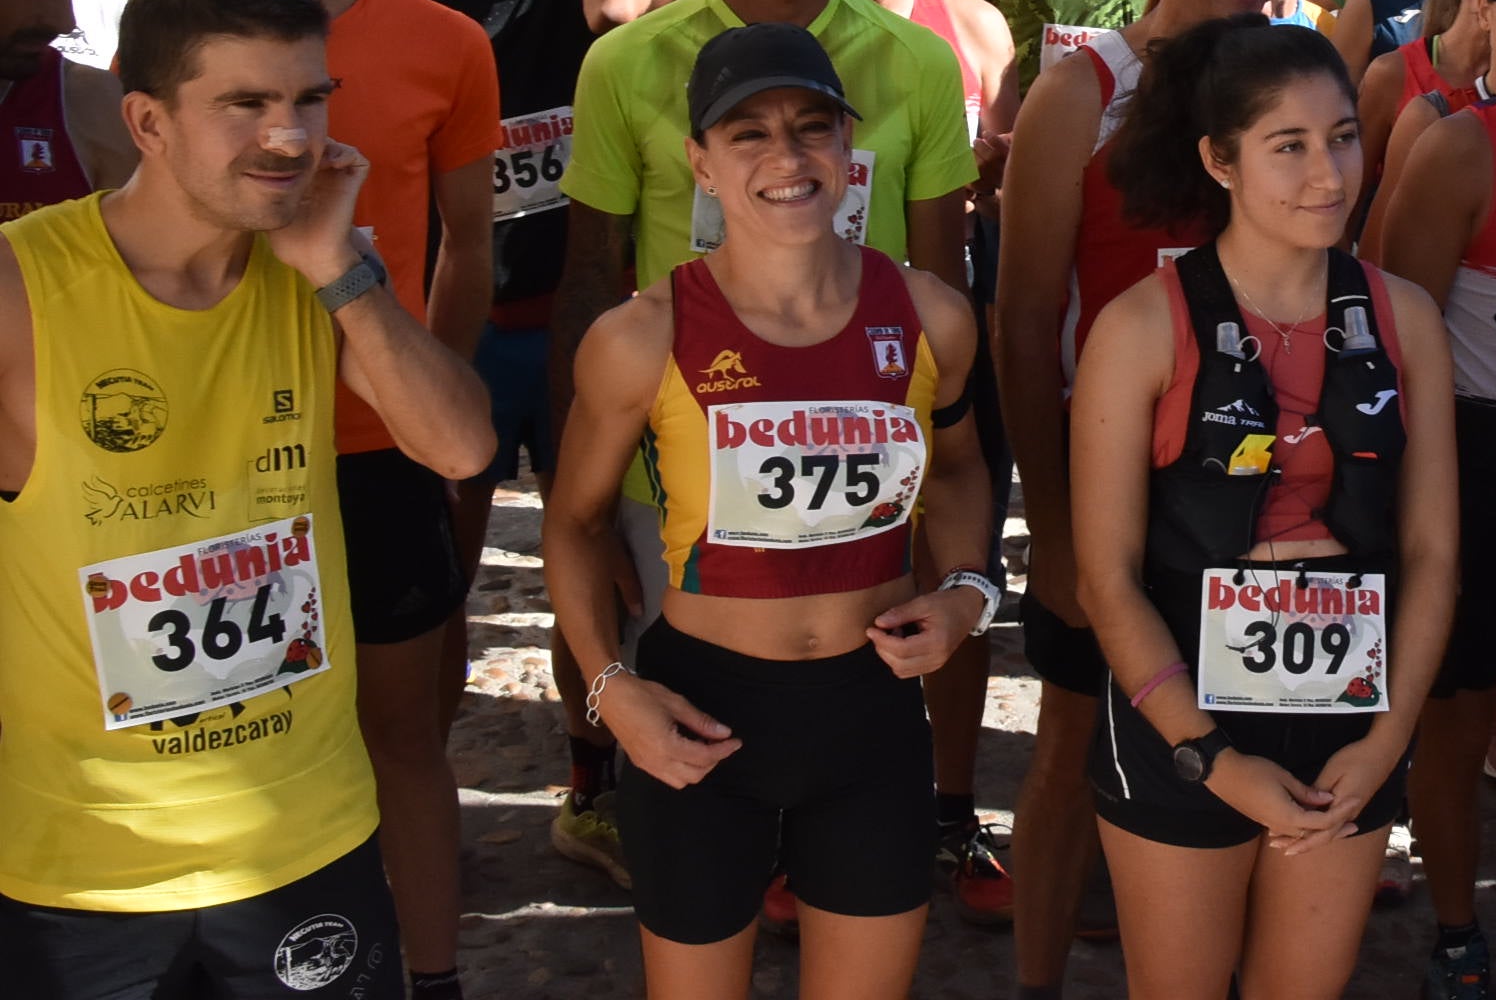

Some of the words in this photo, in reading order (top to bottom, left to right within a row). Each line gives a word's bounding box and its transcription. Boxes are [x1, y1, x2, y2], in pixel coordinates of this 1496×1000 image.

[492, 144, 564, 194] 356
[696, 375, 762, 394] austral
[715, 409, 919, 450] bedunia
[126, 477, 207, 498] calcetines
[757, 453, 881, 511] 375
[120, 491, 216, 521] ALARVI
[87, 532, 311, 614] bedunia
[1208, 576, 1380, 616] bedunia
[147, 584, 287, 672] 364
[1242, 620, 1351, 675] 309
[151, 709, 294, 755] valdezcaray
